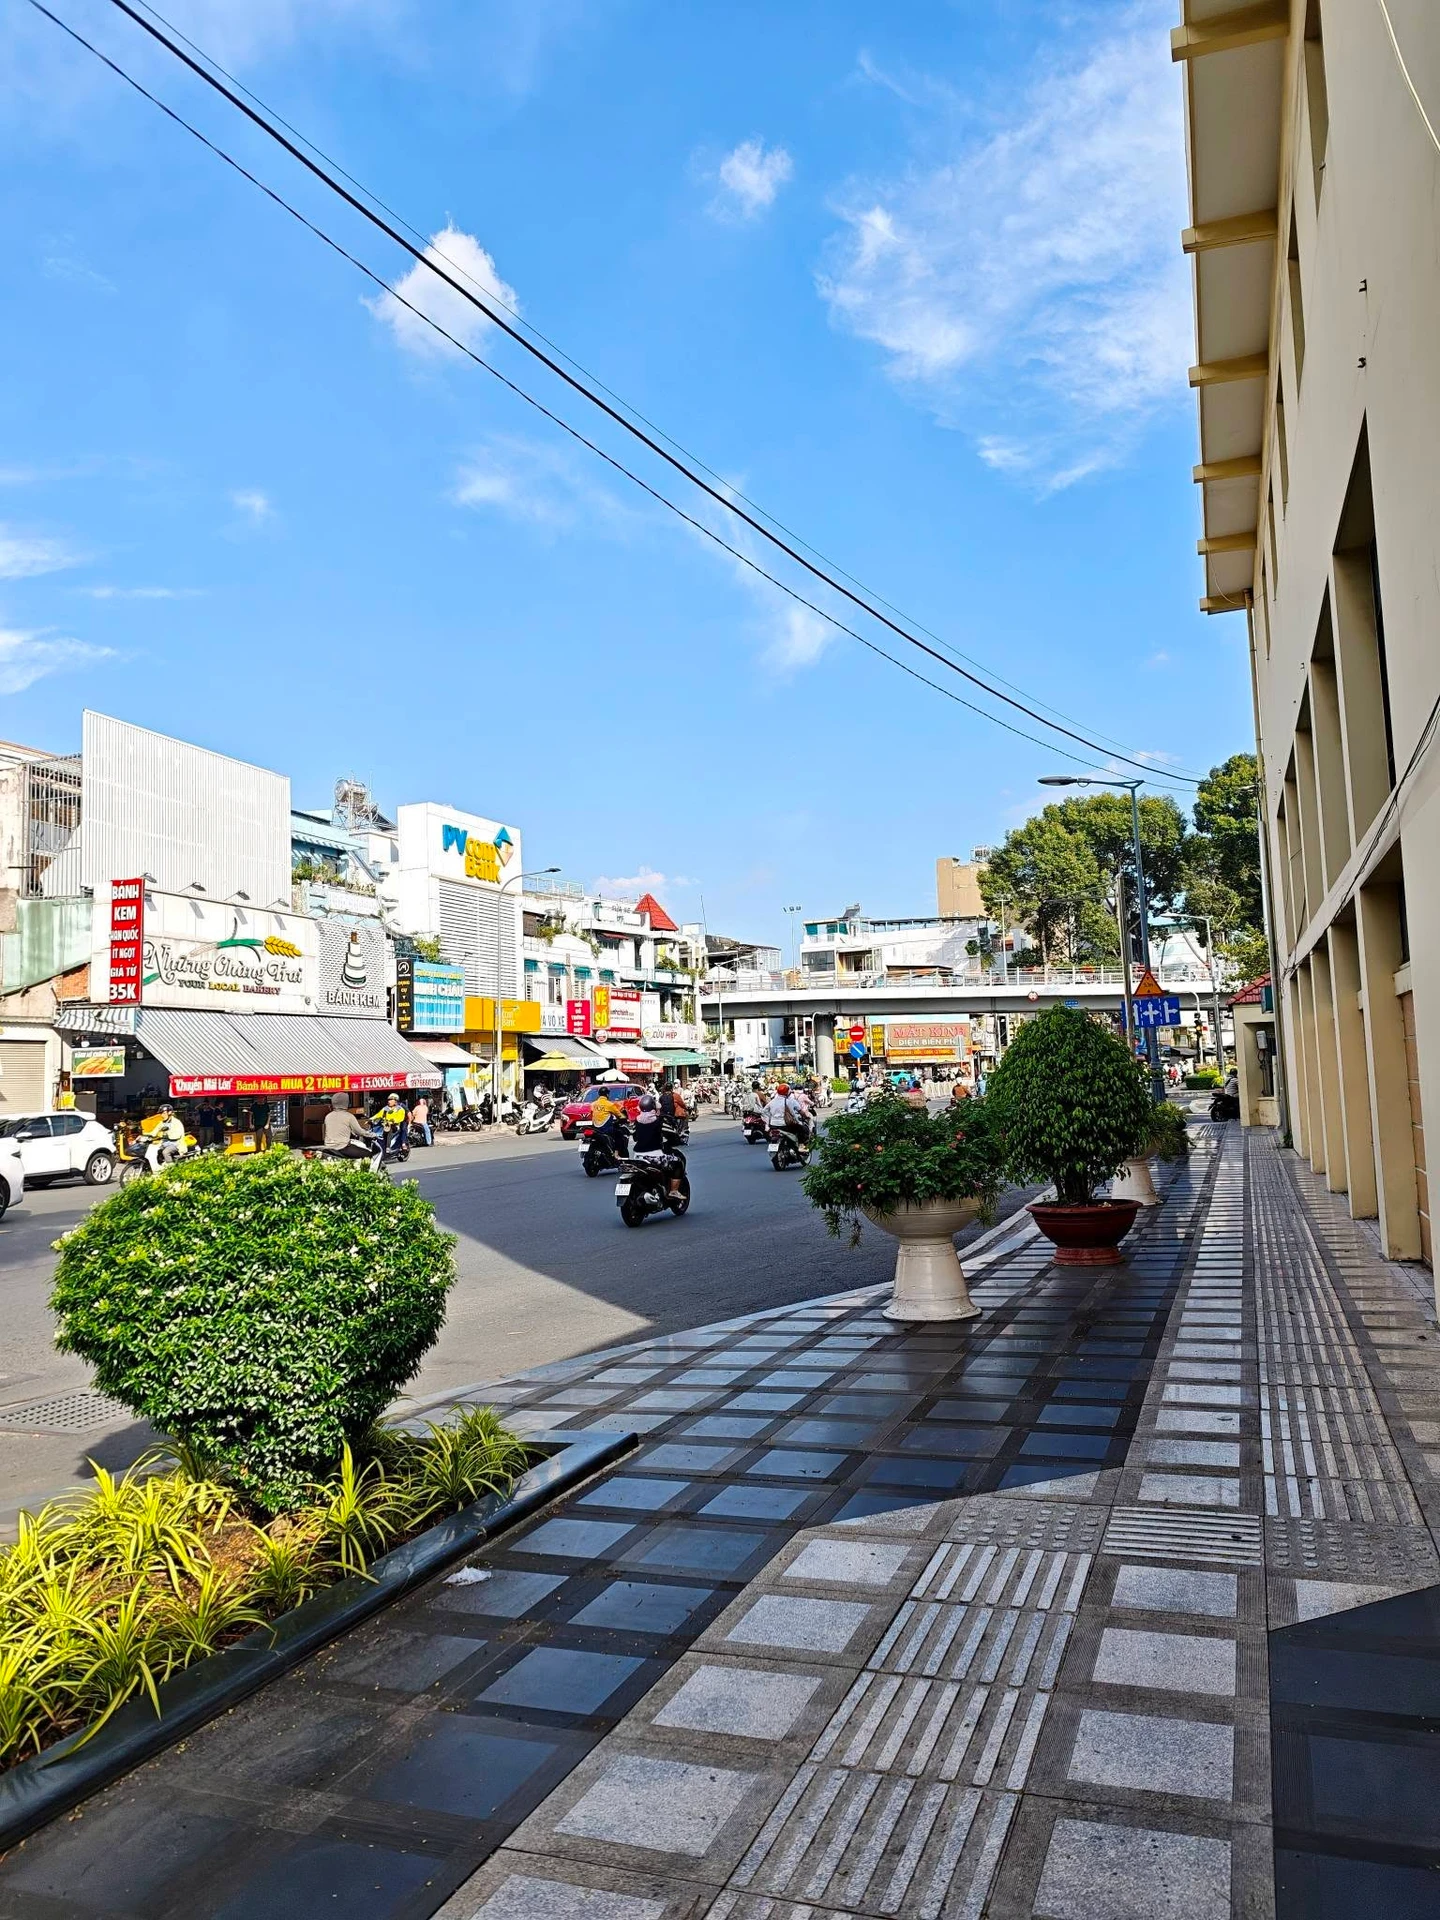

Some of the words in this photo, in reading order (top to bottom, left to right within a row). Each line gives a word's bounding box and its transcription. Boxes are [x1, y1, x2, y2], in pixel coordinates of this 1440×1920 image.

[465, 855, 501, 885] Bank
[112, 881, 140, 900] BÁNH
[114, 905, 137, 921] KEM
[122, 924, 139, 942] QUỐC
[119, 946, 136, 961] NGỌT
[110, 964, 124, 978] GIÁ
[126, 963, 137, 977] TỪ
[109, 983, 137, 1000] 35K
[178, 979, 206, 989] YOUR
[208, 981, 240, 992] LOCAL
[242, 984, 281, 995] BAKERY
[595, 986, 607, 1005] VÉ
[327, 988, 357, 1006] BÁNH
[359, 993, 380, 1008] KEM
[557, 1015, 565, 1026] XE
[595, 1005, 607, 1028] SỐ
[236, 1080, 259, 1091] Bánh
[280, 1078, 303, 1090] MUA
[305, 1076, 314, 1090] 2
[317, 1075, 341, 1091] TẶNG
[342, 1074, 350, 1090] 1
